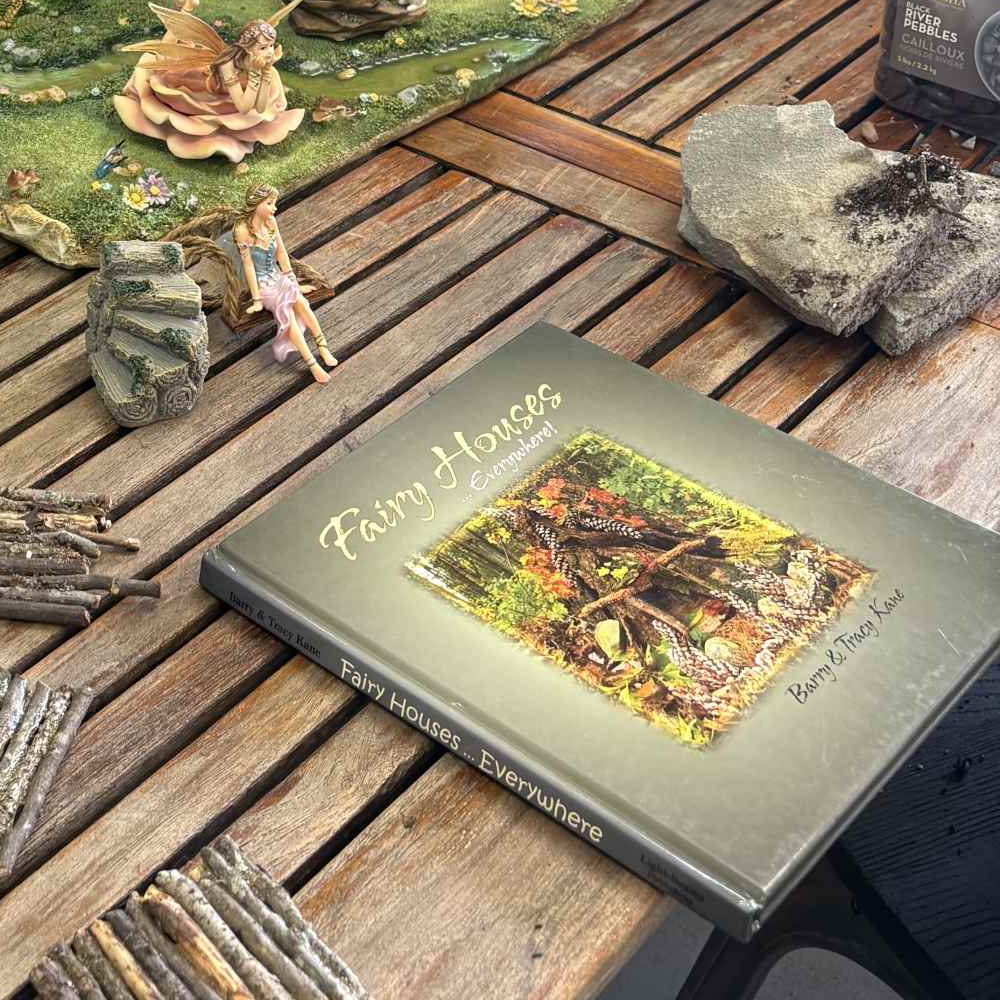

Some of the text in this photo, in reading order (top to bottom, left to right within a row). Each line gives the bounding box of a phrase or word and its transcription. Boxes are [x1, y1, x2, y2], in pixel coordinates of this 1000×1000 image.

[903, 18, 958, 43] PEBBLES
[905, 8, 941, 28] RIVER
[906, 1, 930, 14] BLACK
[902, 33, 965, 61] CAILLOUX
[318, 383, 562, 561] Fairy Houses
[229, 591, 321, 658] Barry & Tracy Kane
[786, 588, 905, 705] Barry & Tracy Kane
[339, 658, 385, 700] Fairy
[389, 694, 462, 750] Houses
[478, 749, 604, 842] Everywhere
